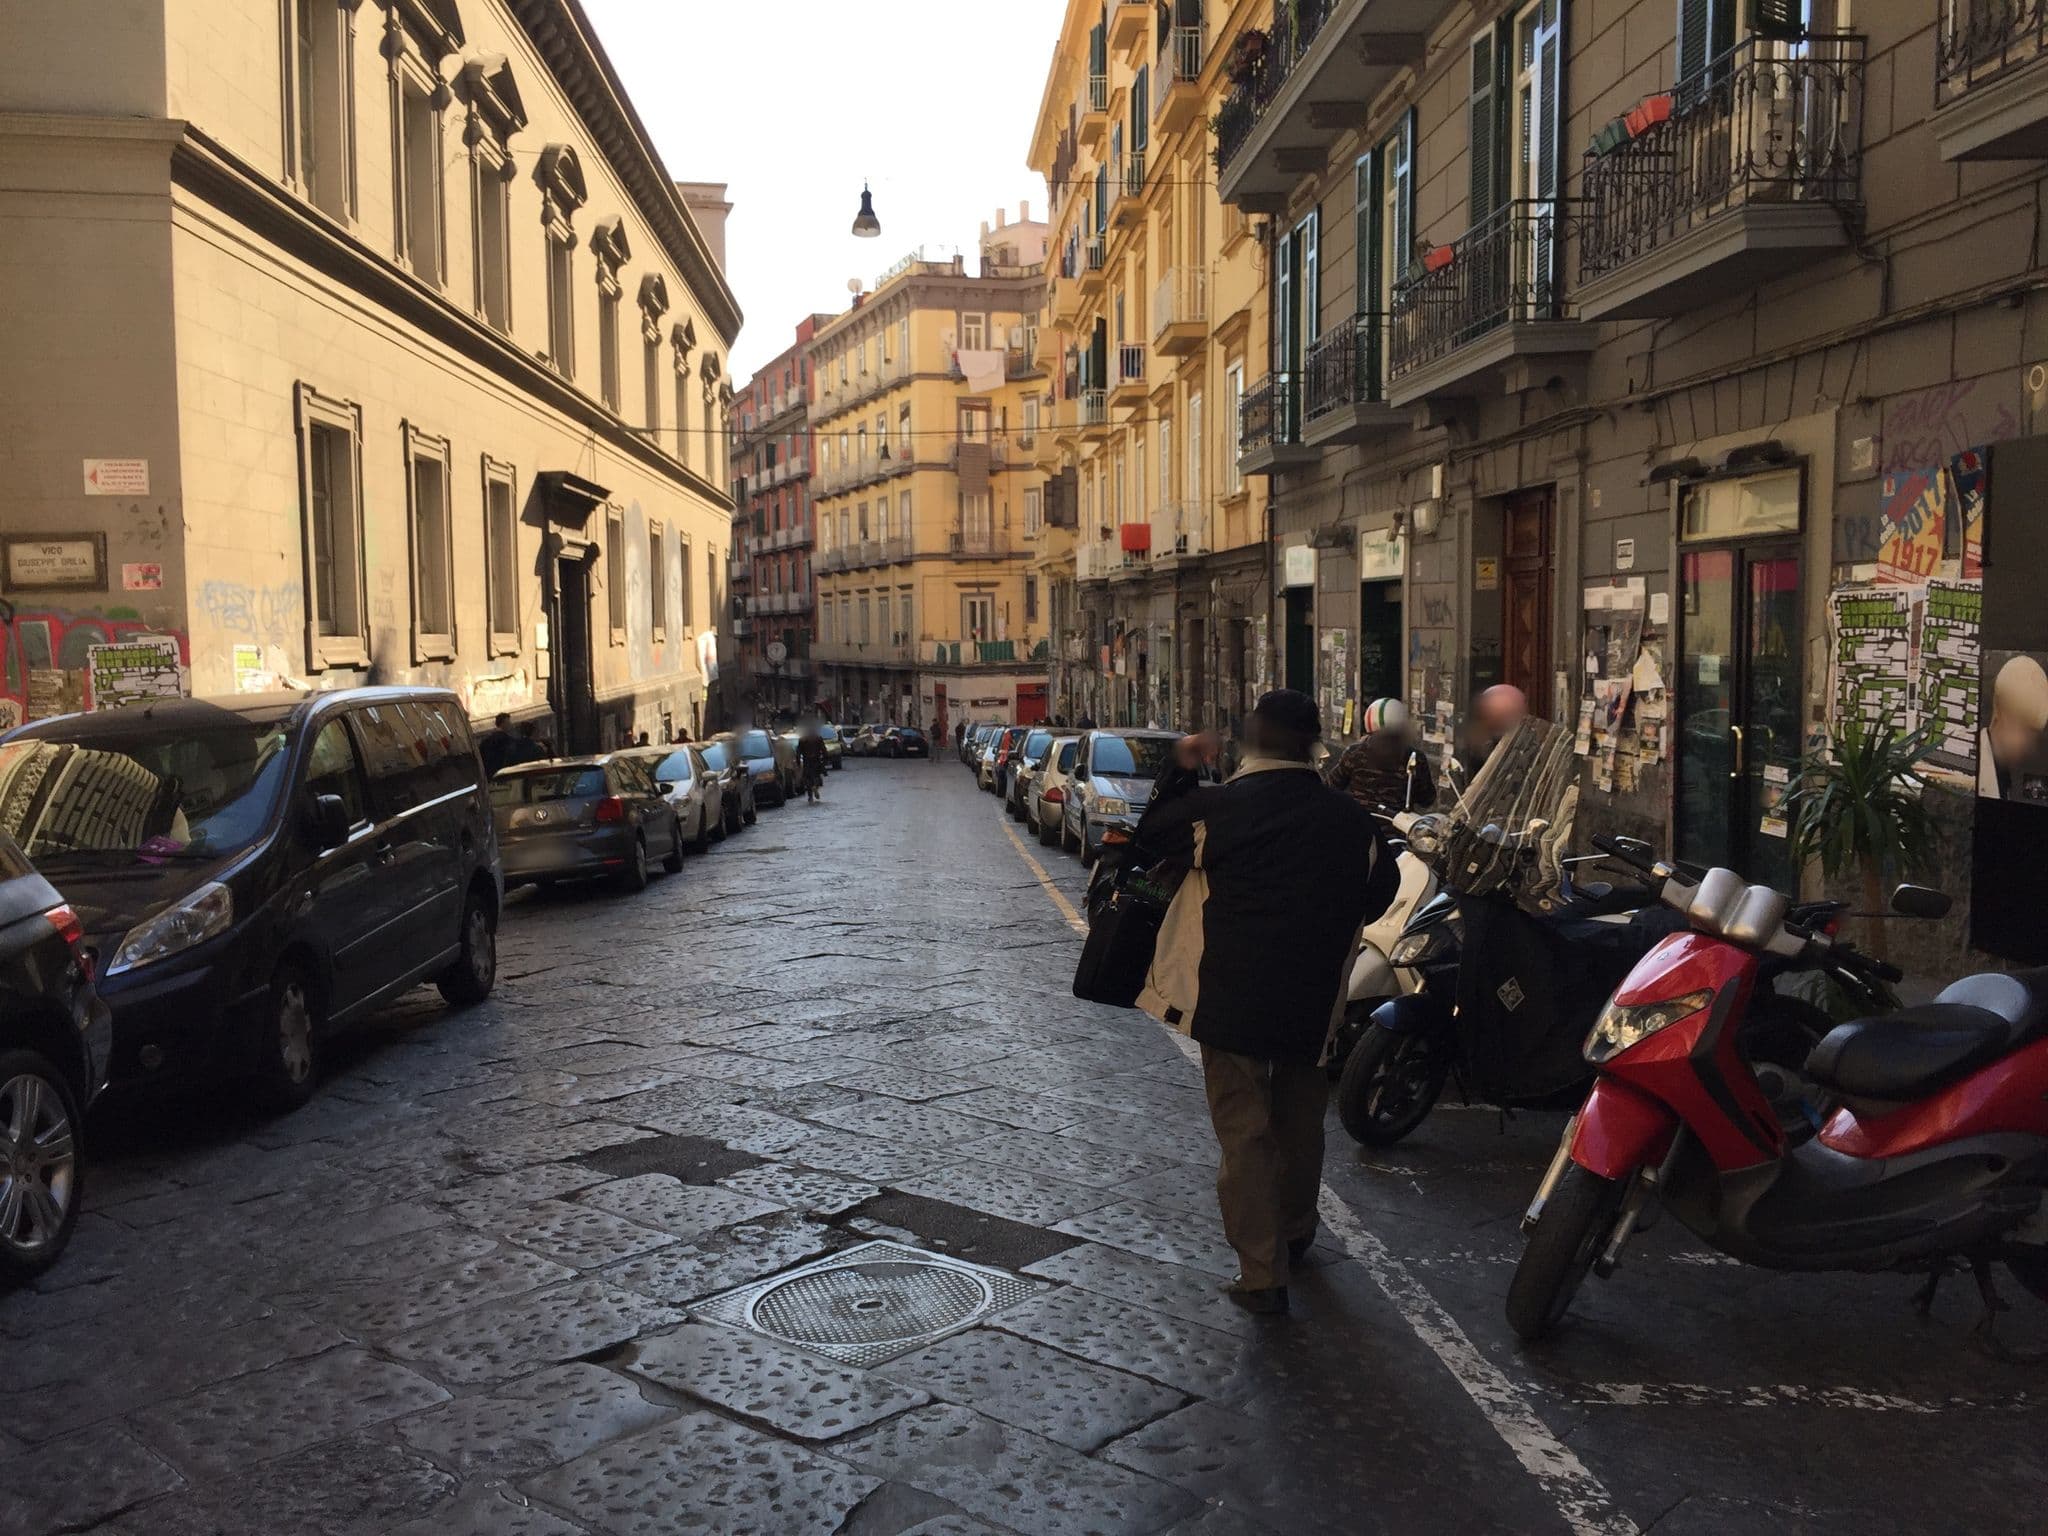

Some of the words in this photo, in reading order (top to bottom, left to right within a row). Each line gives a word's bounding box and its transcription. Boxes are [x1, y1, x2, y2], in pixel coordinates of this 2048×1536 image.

[41, 546, 63, 555] VICO
[17, 557, 55, 567] GIUSEPPE
[1891, 537, 1938, 577] 1917
